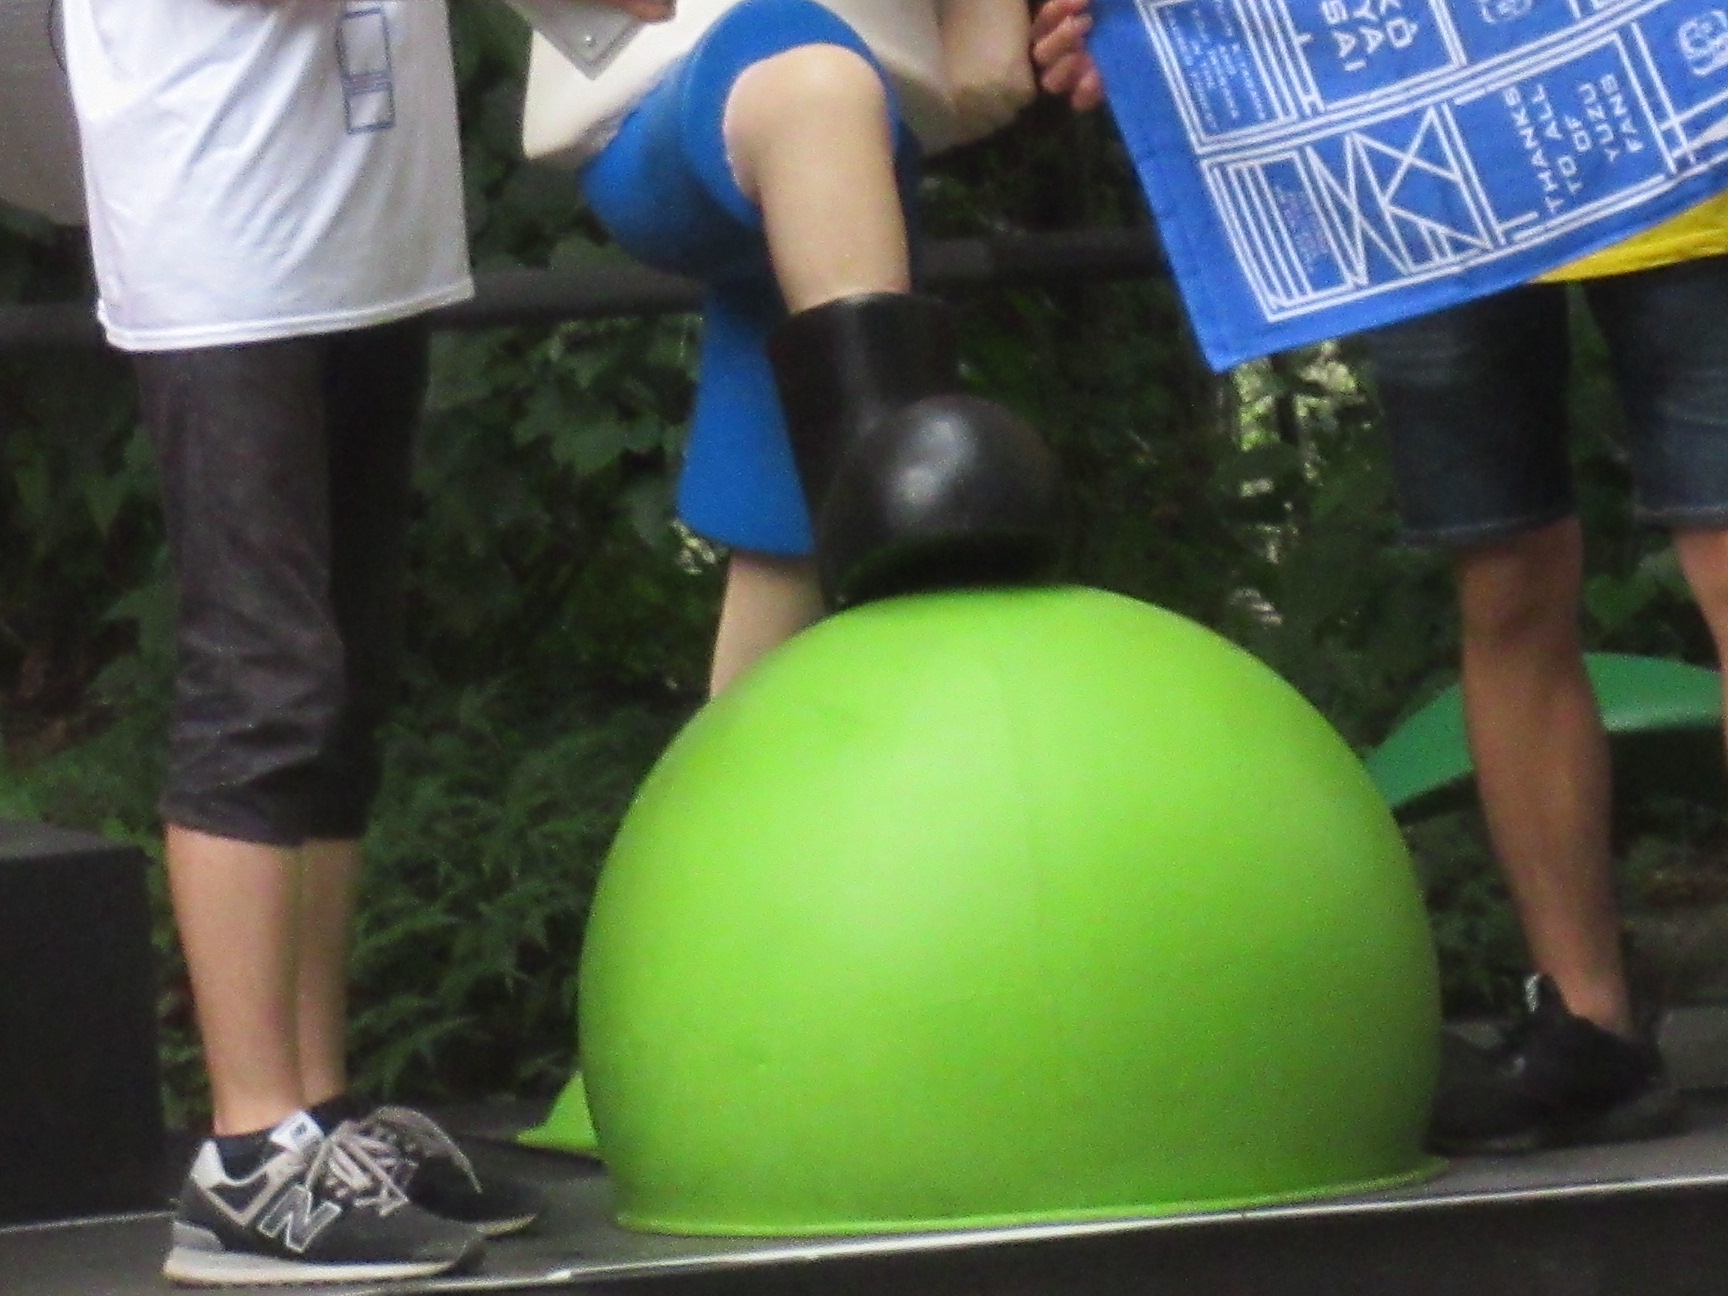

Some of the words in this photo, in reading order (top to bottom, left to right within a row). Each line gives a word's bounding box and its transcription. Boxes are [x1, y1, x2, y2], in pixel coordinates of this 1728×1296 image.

[1534, 87, 1563, 139] ALL
[1565, 117, 1592, 153] OF
[1579, 83, 1619, 162] YUZU
[1602, 75, 1643, 154] FANS
[1502, 87, 1562, 213] THANKS
[1557, 155, 1582, 194] TO
[256, 1184, 342, 1254] N
